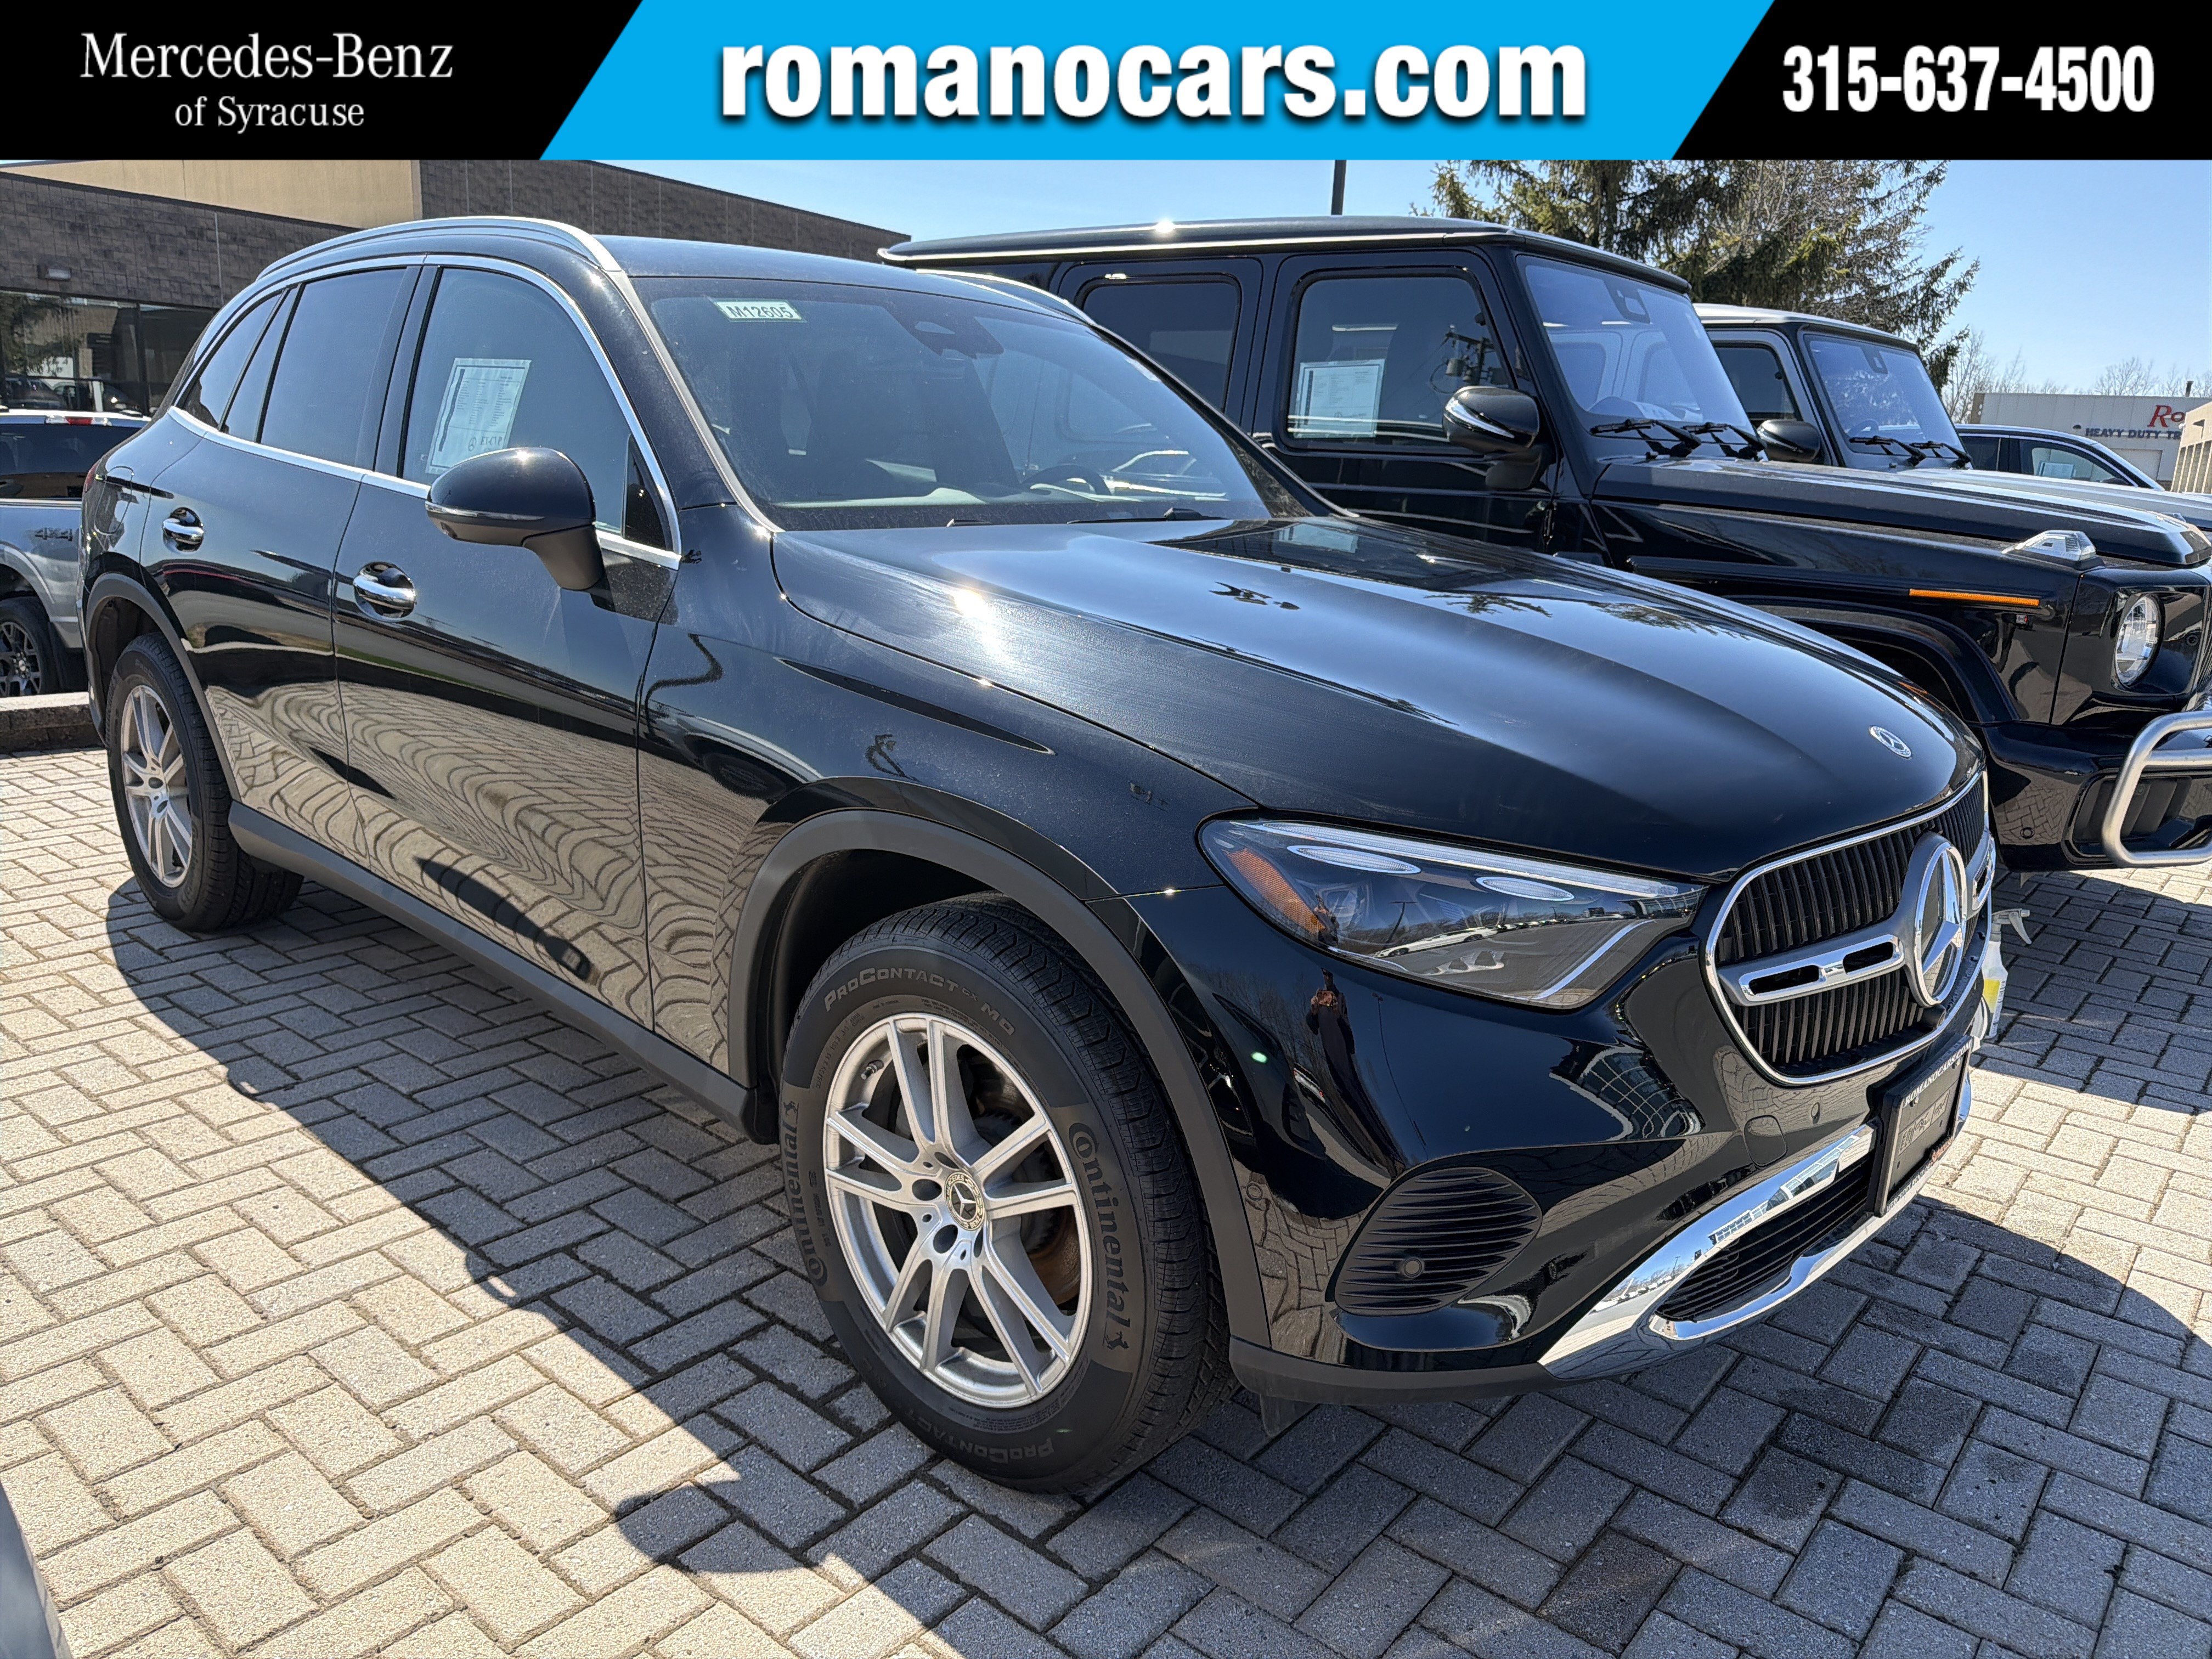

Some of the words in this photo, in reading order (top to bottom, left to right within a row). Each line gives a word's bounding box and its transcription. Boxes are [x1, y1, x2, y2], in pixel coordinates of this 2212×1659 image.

[726, 306, 793, 318] M12605
[2085, 428, 2124, 438] HEAVY
[2128, 429, 2162, 439] DUTY
[782, 1121, 828, 1287] Continental
[1069, 1122, 1131, 1328] Continental
